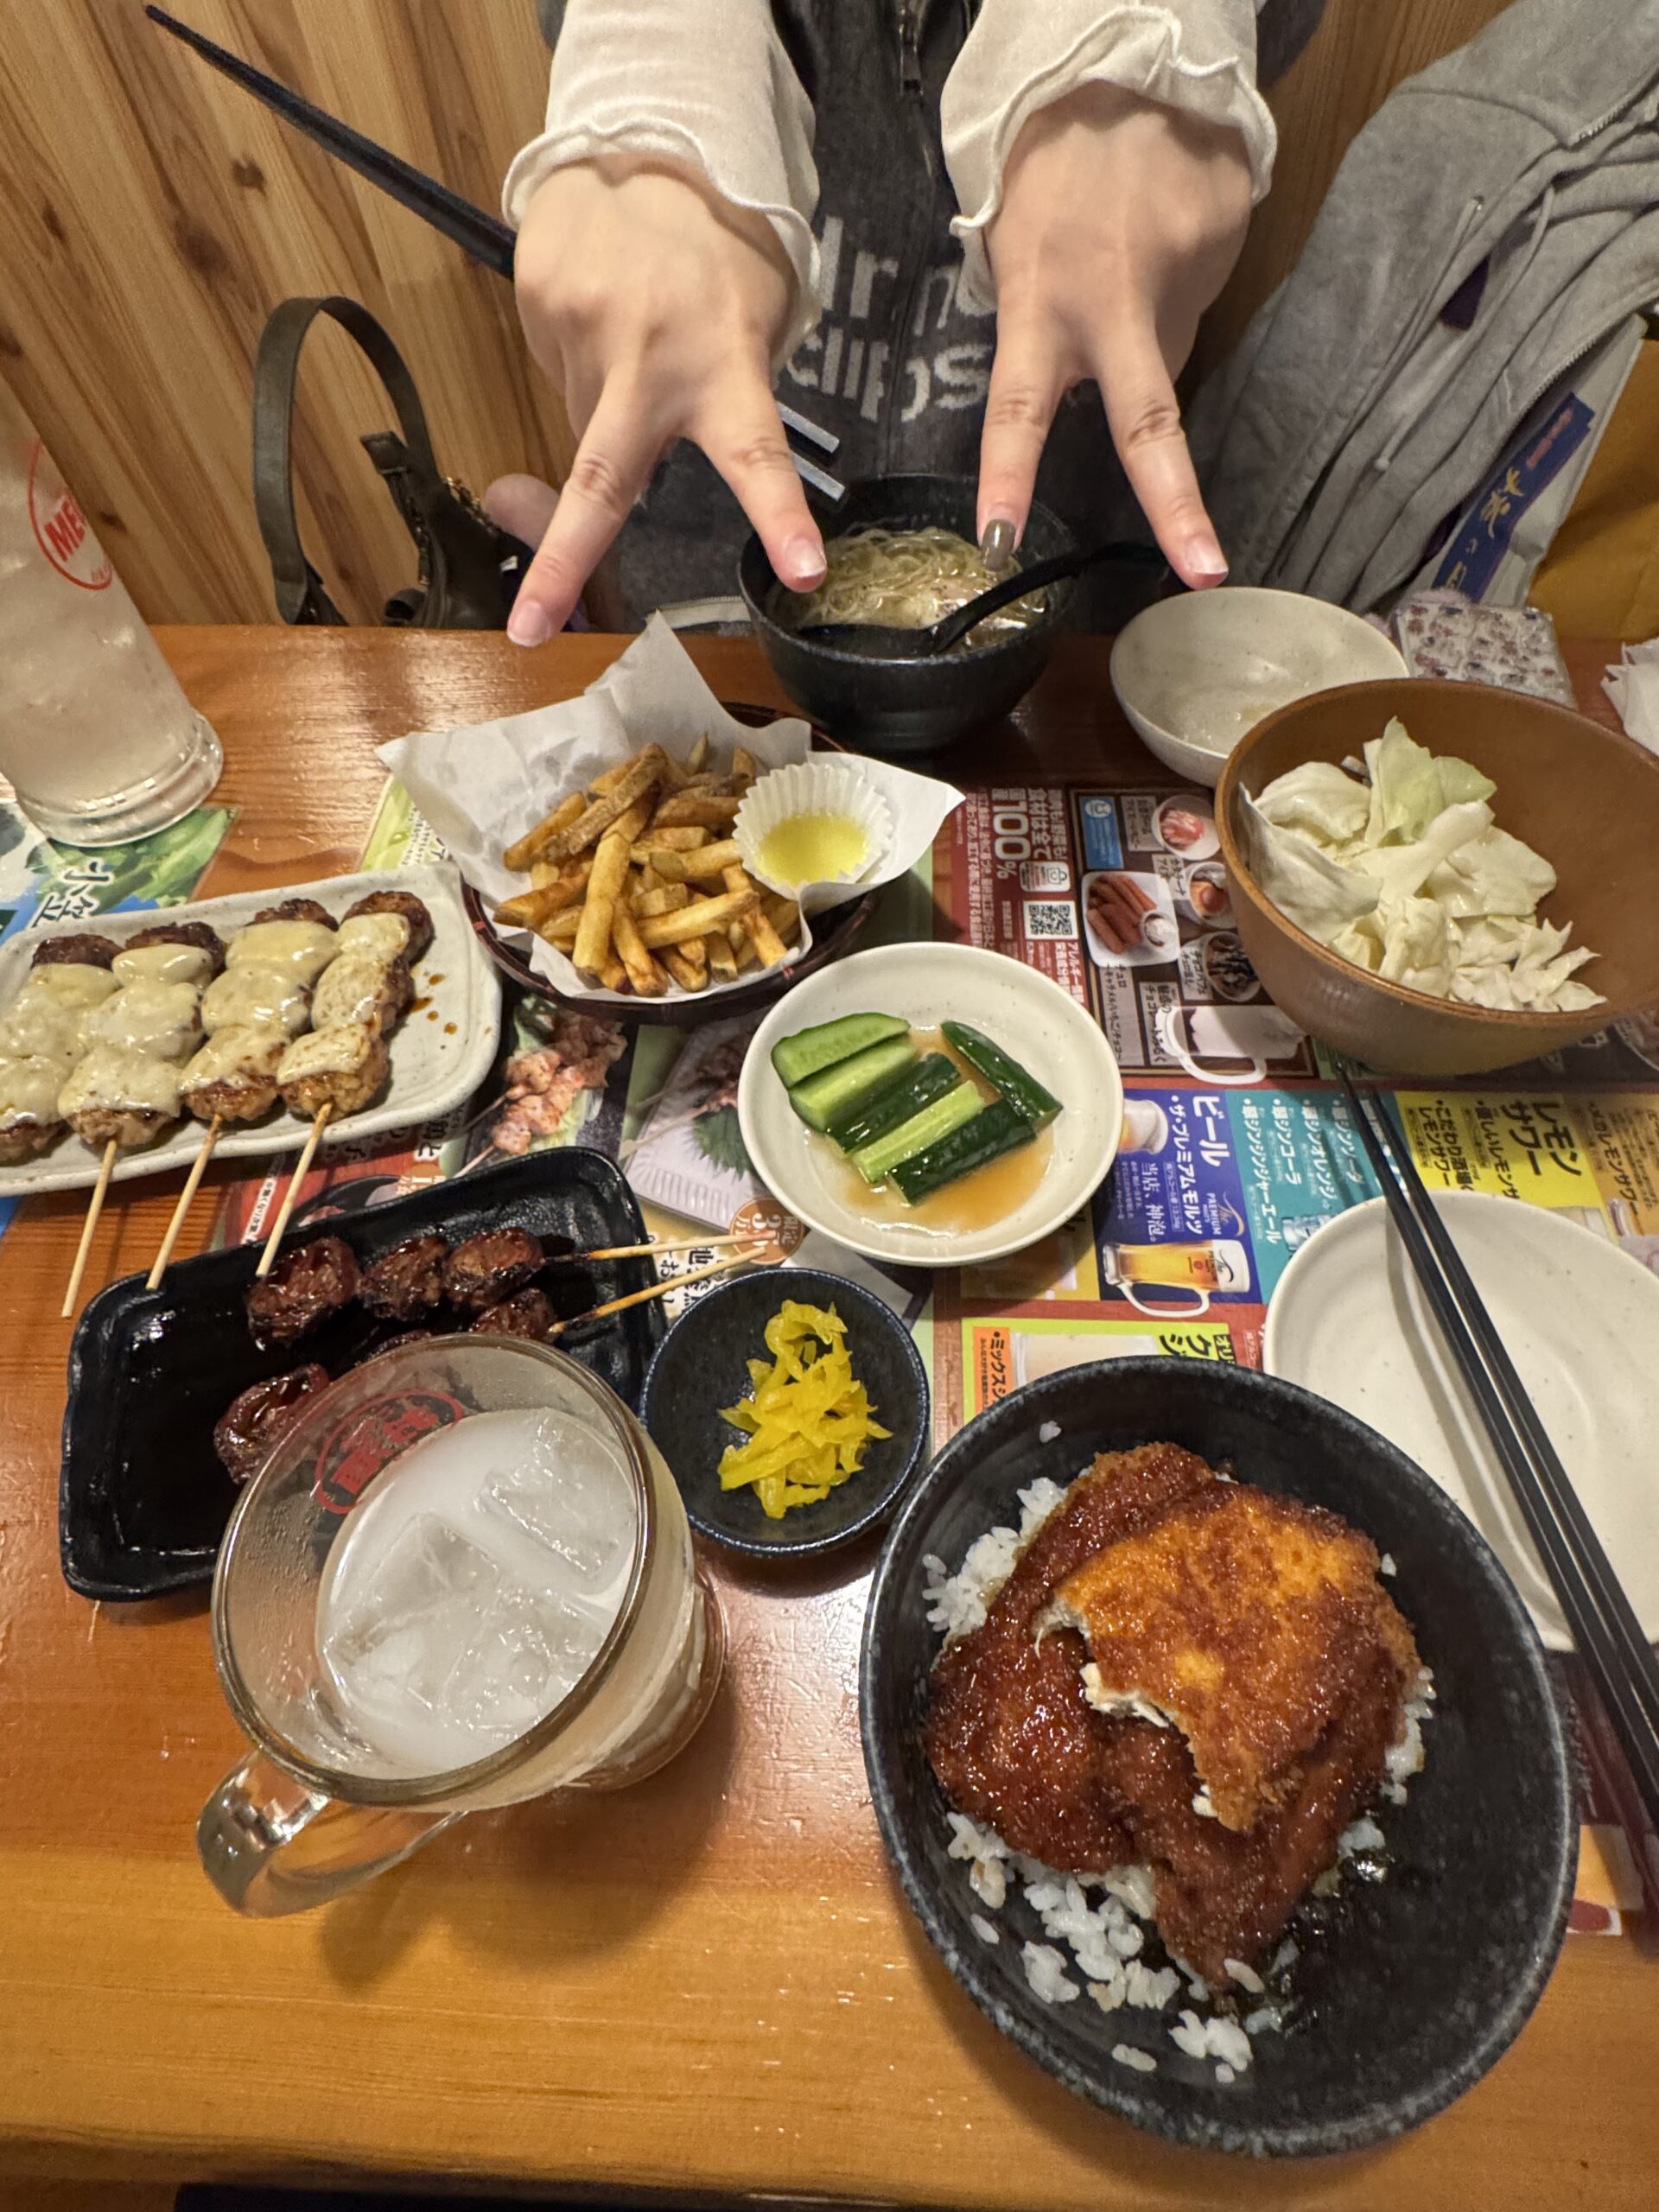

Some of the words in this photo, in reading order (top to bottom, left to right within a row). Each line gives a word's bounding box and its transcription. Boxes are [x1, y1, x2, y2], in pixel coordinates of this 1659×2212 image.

[1027, 787, 1051, 860] 食材は全て
[1192, 1096, 1230, 1167] ビール
[1418, 1107, 1452, 1186] レモンサワー
[1500, 1101, 1542, 1176] サワー
[1531, 1102, 1582, 1176] レモン
[1206, 1192, 1222, 1235] PREMIUM
